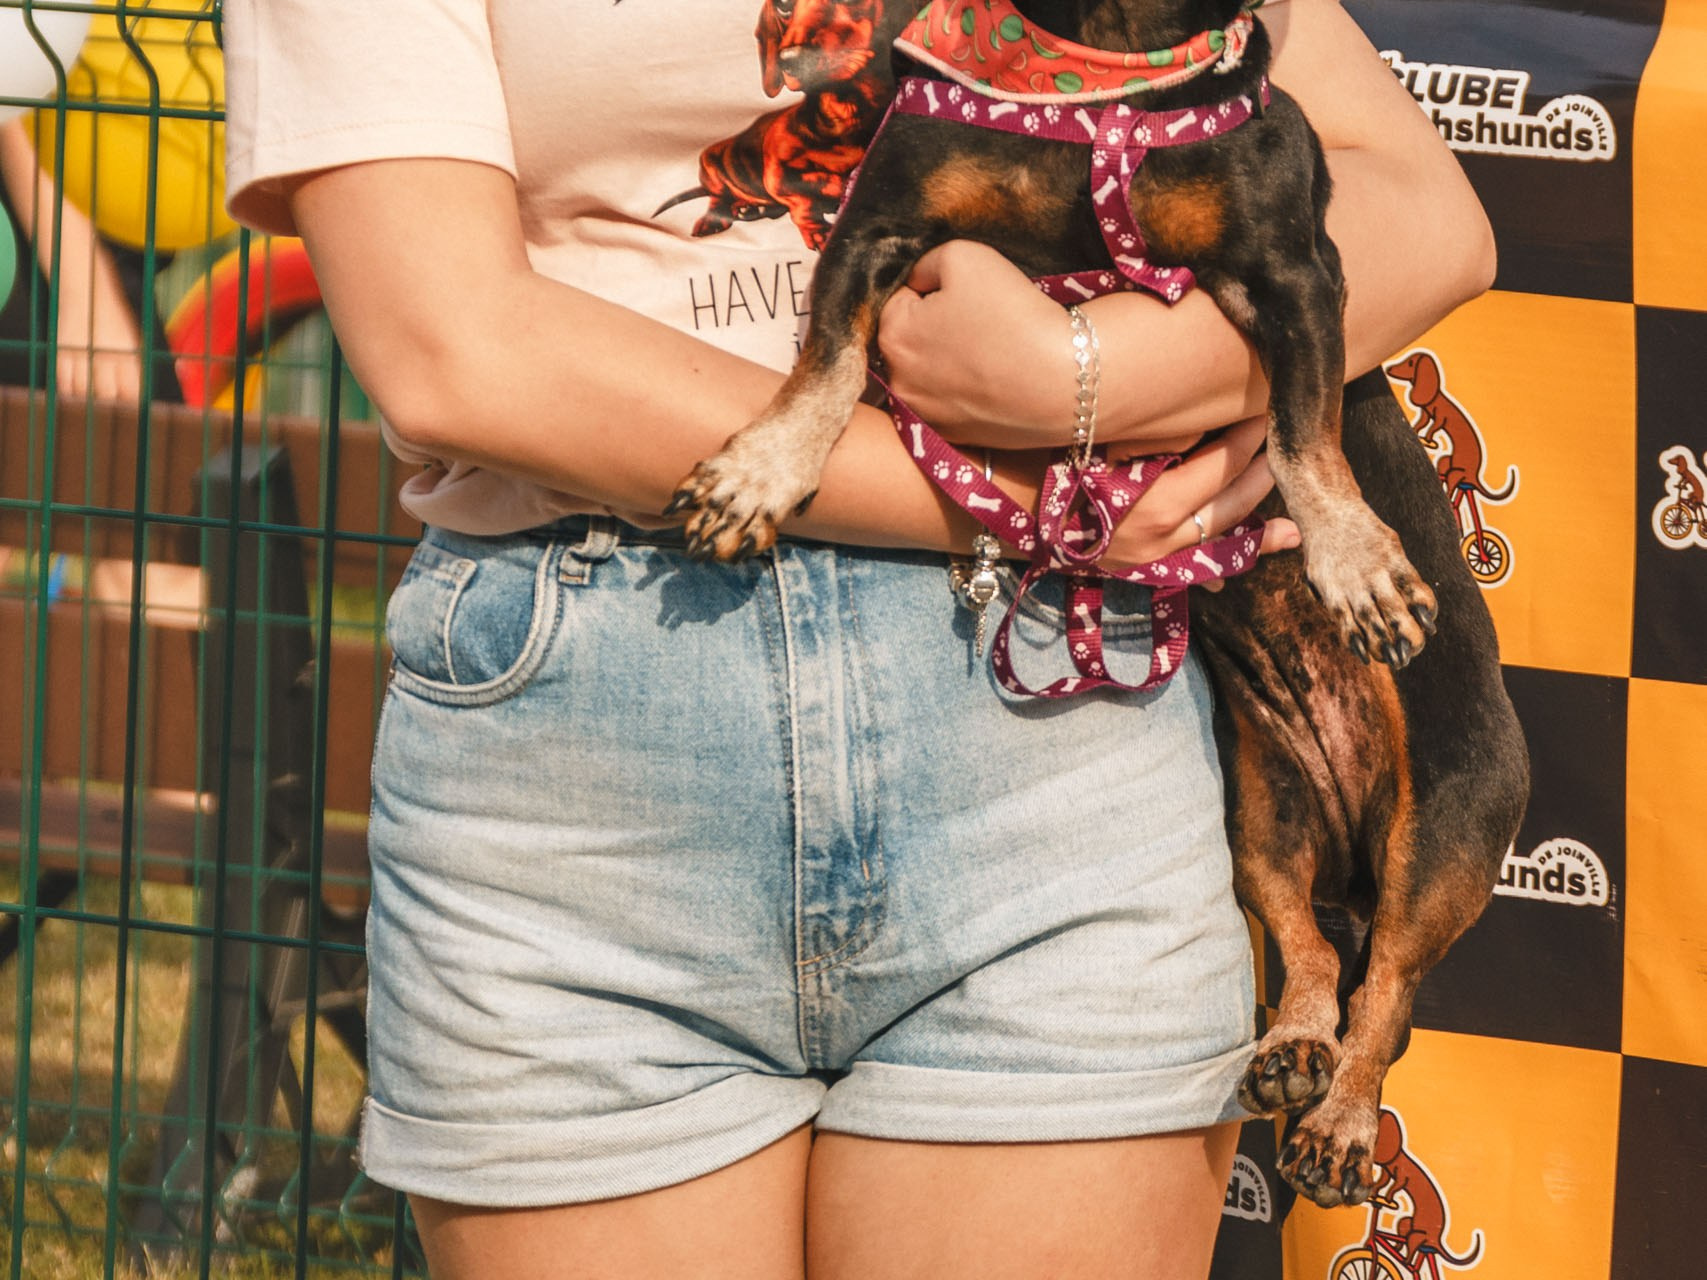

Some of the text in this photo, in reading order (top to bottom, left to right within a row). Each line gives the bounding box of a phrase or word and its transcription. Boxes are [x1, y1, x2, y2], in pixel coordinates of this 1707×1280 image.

[1565, 103, 1608, 151] JOINVILLE
[689, 261, 810, 330] HAVE
[1556, 846, 1601, 897] JOINVILLE
